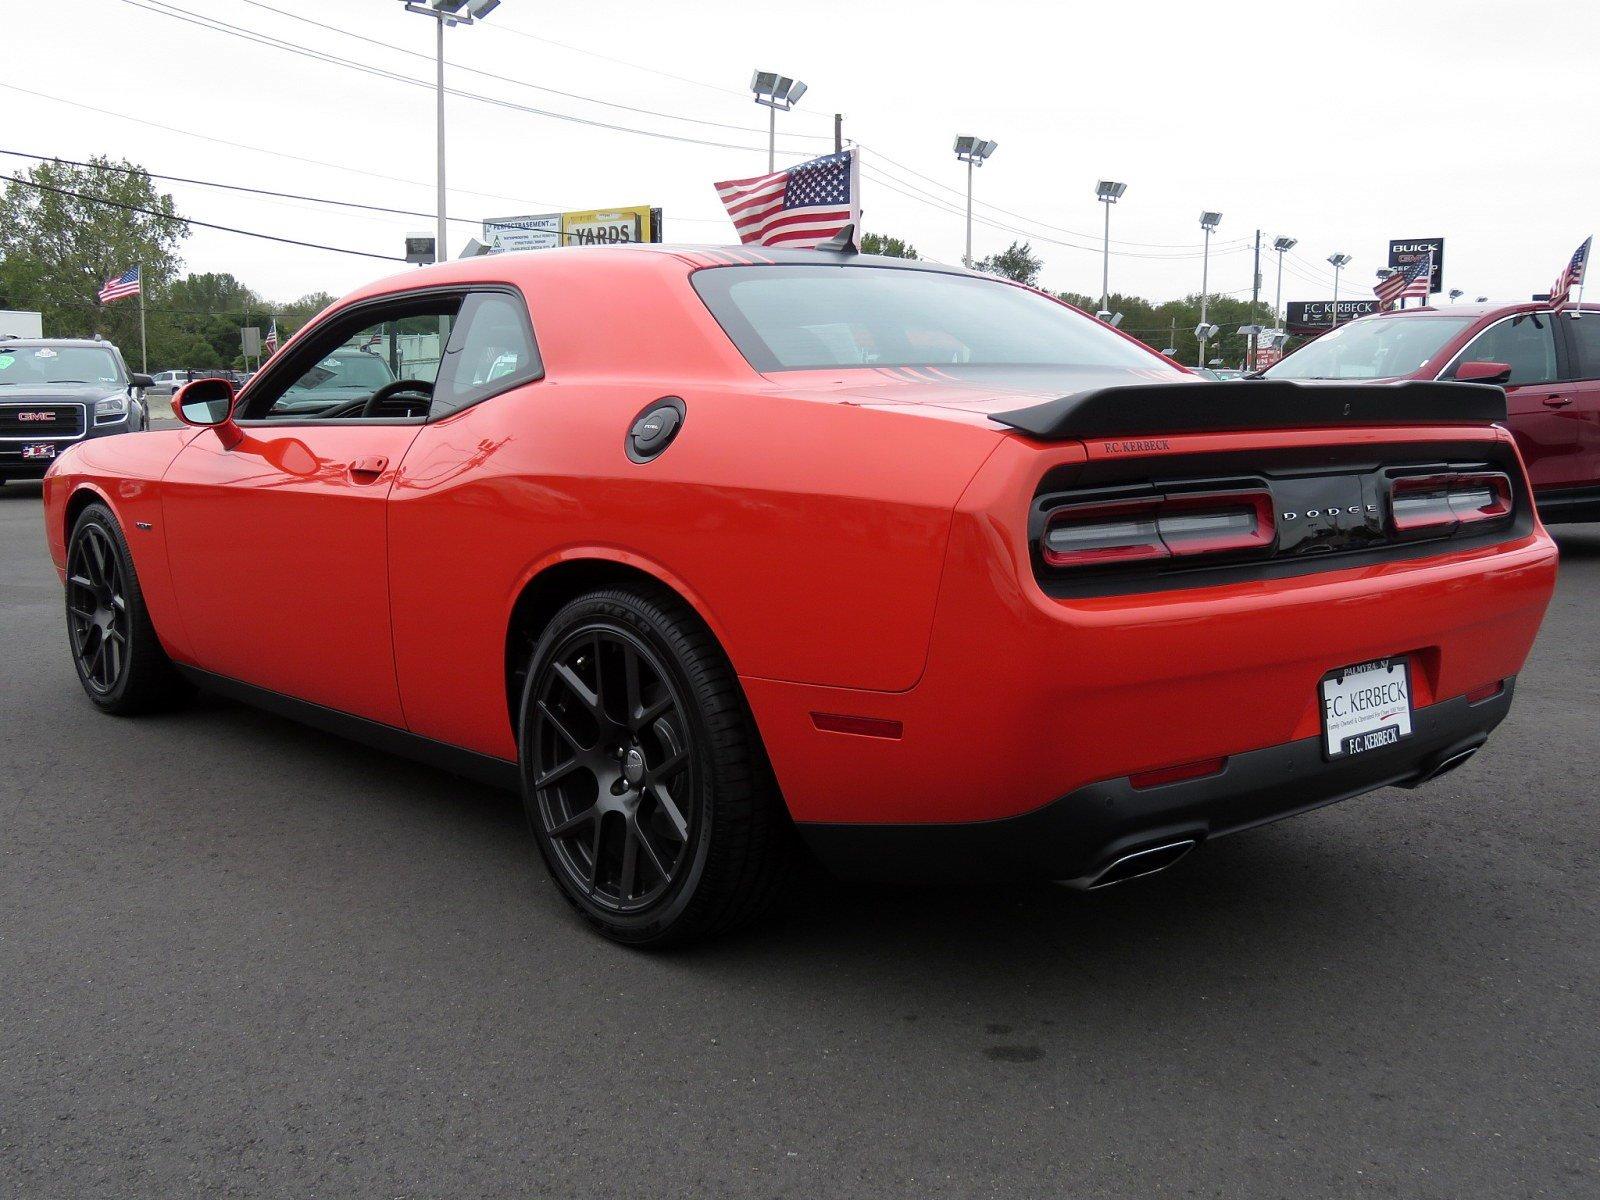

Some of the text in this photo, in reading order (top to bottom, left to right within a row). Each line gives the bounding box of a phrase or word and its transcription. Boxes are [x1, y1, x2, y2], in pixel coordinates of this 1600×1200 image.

[575, 225, 630, 245] YARDS
[1392, 243, 1438, 253] BUICK
[1304, 303, 1322, 313] F.C.
[18, 412, 56, 421] GMC
[1282, 504, 1377, 521] DODGE
[1324, 681, 1406, 720] F.C. KERBECK
[1349, 727, 1398, 755] F.C. KERBECK
